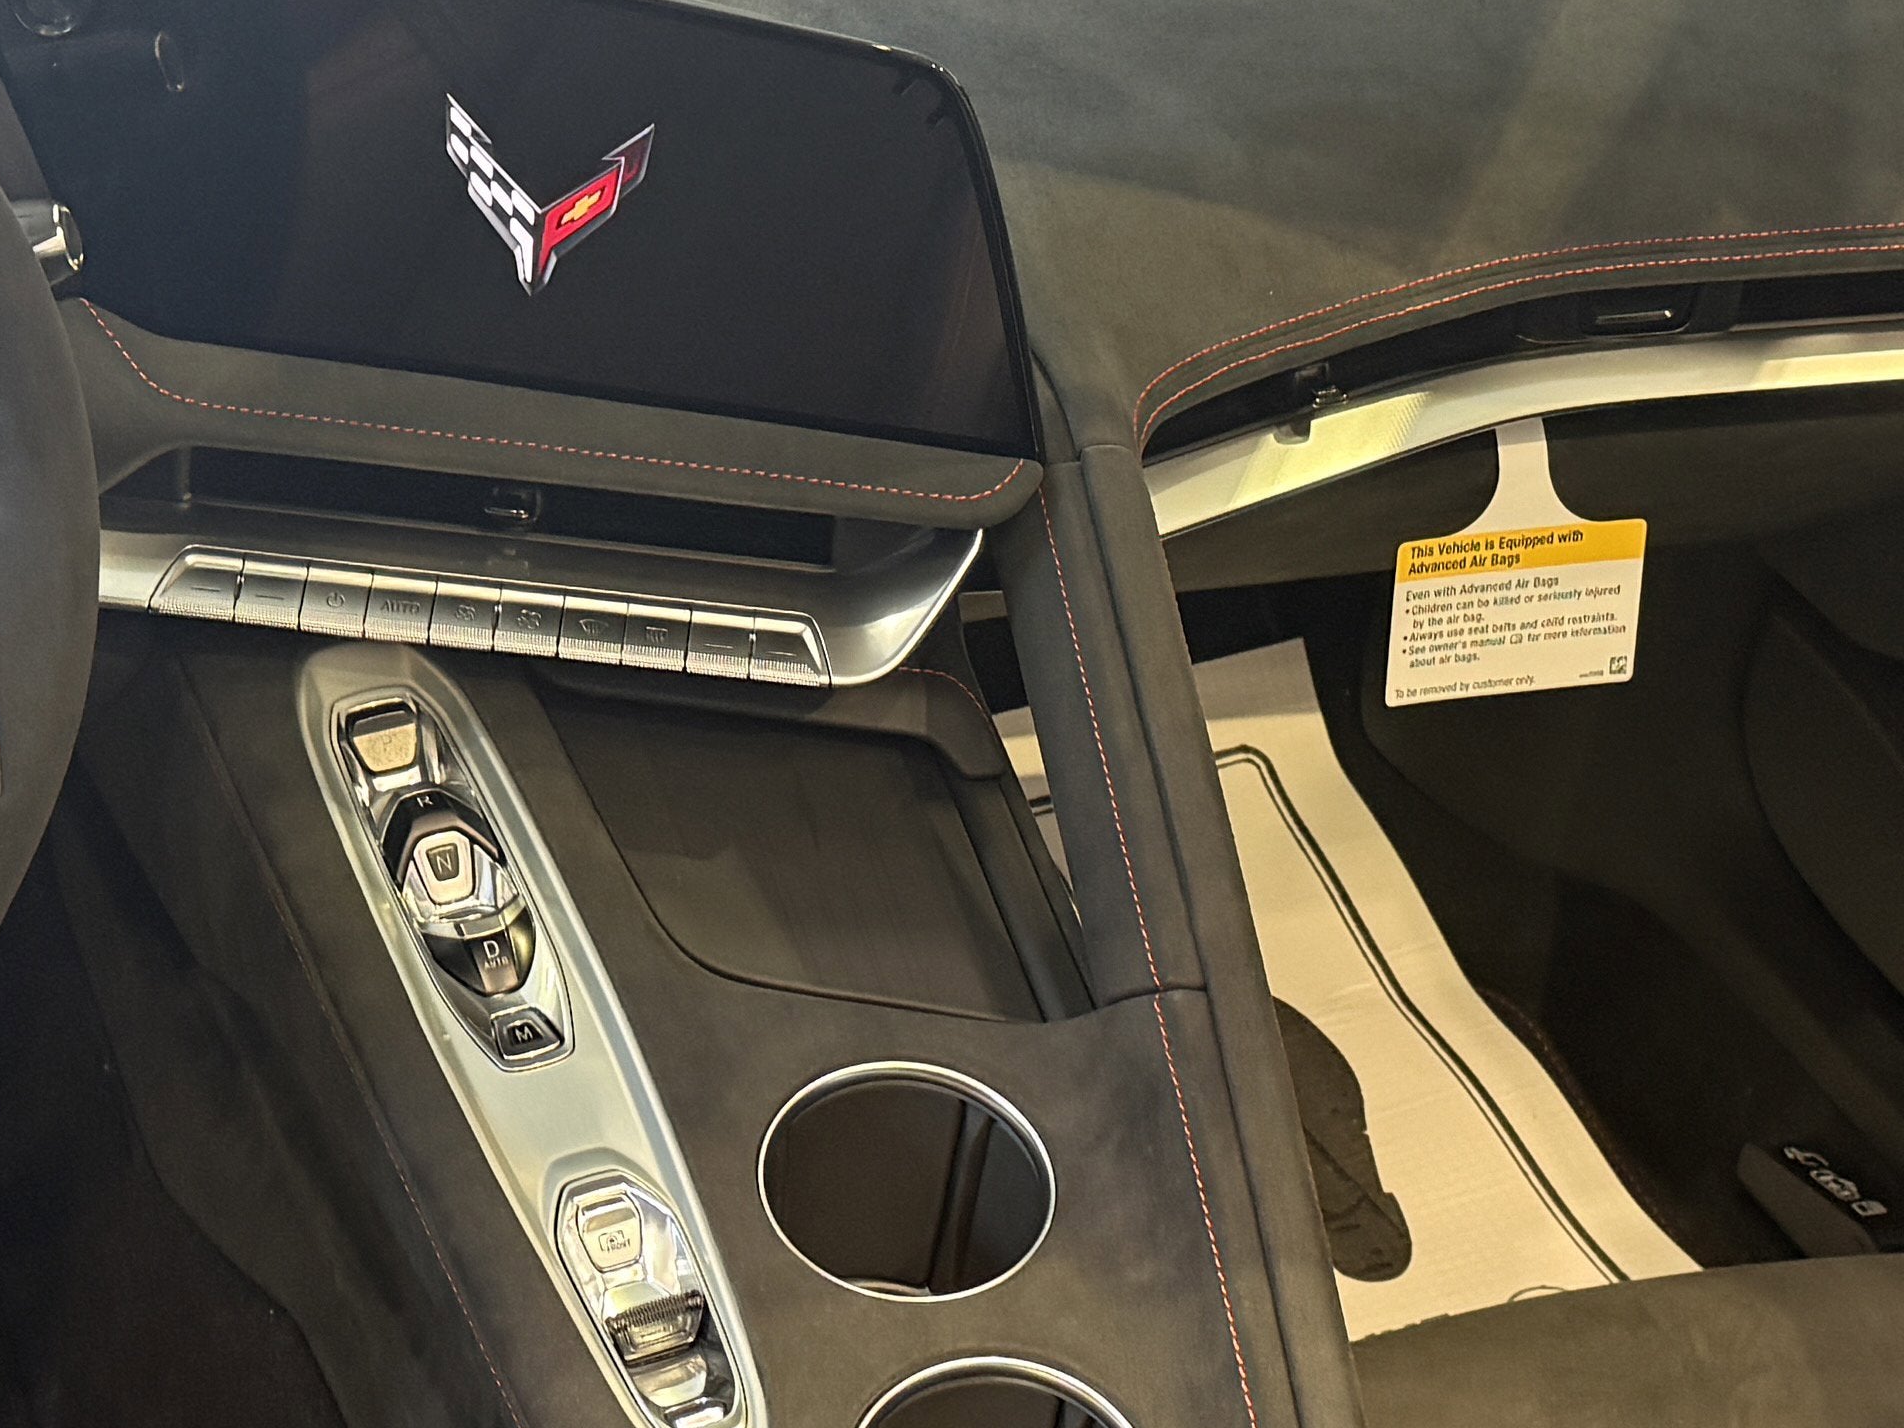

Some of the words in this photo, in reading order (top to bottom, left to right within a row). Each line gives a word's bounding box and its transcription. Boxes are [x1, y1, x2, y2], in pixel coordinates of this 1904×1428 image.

[1411, 545, 1434, 559] This
[1439, 540, 1481, 555] Vehicle
[1485, 537, 1495, 550] is
[1499, 531, 1554, 550] Equipped
[1558, 529, 1583, 542] with
[1408, 557, 1466, 576] Advanced
[1470, 554, 1486, 568] Air
[1491, 553, 1520, 568] Bags
[1406, 590, 1430, 602] Even
[1434, 586, 1456, 597] with
[1459, 580, 1512, 595] Advanced
[1515, 578, 1529, 590] Air
[1533, 576, 1559, 589] Bags
[380, 598, 420, 615] AUTO
[1412, 602, 1452, 615] Children
[1456, 600, 1474, 611] can
[1477, 598, 1489, 608] be
[1524, 595, 1533, 603] or
[1537, 589, 1582, 602] seriously
[1585, 585, 1621, 599] injured
[1409, 630, 1444, 642] Always
[1447, 628, 1464, 637] use
[1468, 624, 1489, 634] seat
[1520, 619, 1538, 630] and
[1413, 619, 1424, 629] by
[1428, 616, 1443, 627] the
[1446, 613, 1460, 623] air
[1463, 613, 1485, 623] bag.
[1408, 645, 1426, 656] See
[1429, 640, 1467, 653] owner's
[1470, 636, 1505, 648] manual
[1543, 630, 1567, 641] more
[1571, 624, 1626, 638] information
[1409, 656, 1436, 668] about
[1439, 655, 1452, 664] air
[1454, 652, 1480, 664] bags.
[1395, 689, 1404, 699] To
[1406, 688, 1417, 698] be
[1419, 682, 1457, 696] removed
[1459, 682, 1470, 692] by
[1472, 678, 1514, 690] customer
[416, 795, 435, 808] R
[437, 854, 453, 875] N
[483, 940, 500, 959] D
[514, 1025, 533, 1043] M
